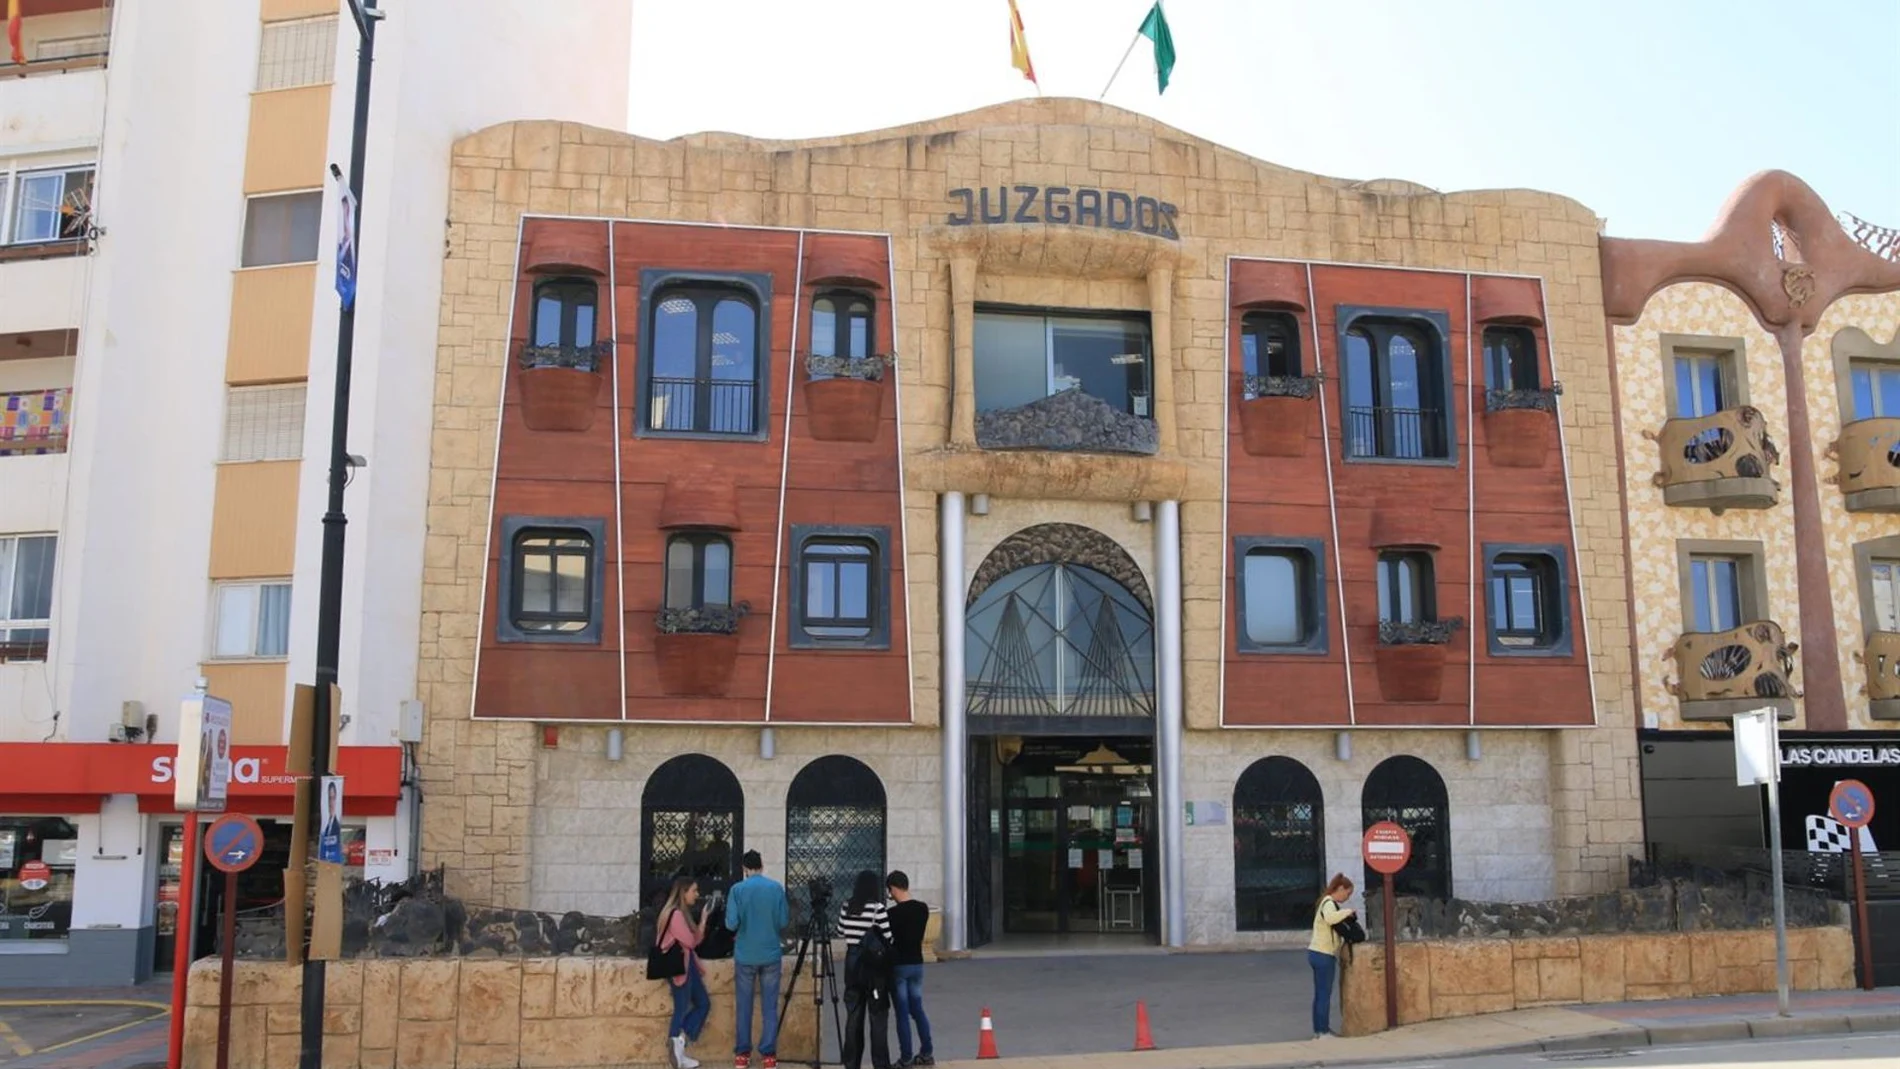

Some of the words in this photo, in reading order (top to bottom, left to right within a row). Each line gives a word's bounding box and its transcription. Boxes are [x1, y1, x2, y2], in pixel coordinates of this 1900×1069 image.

[948, 186, 1180, 240] JUZGADOS
[151, 756, 260, 783] sa
[1779, 748, 1811, 764] LAS
[1814, 748, 1900, 764] CANDELAS
